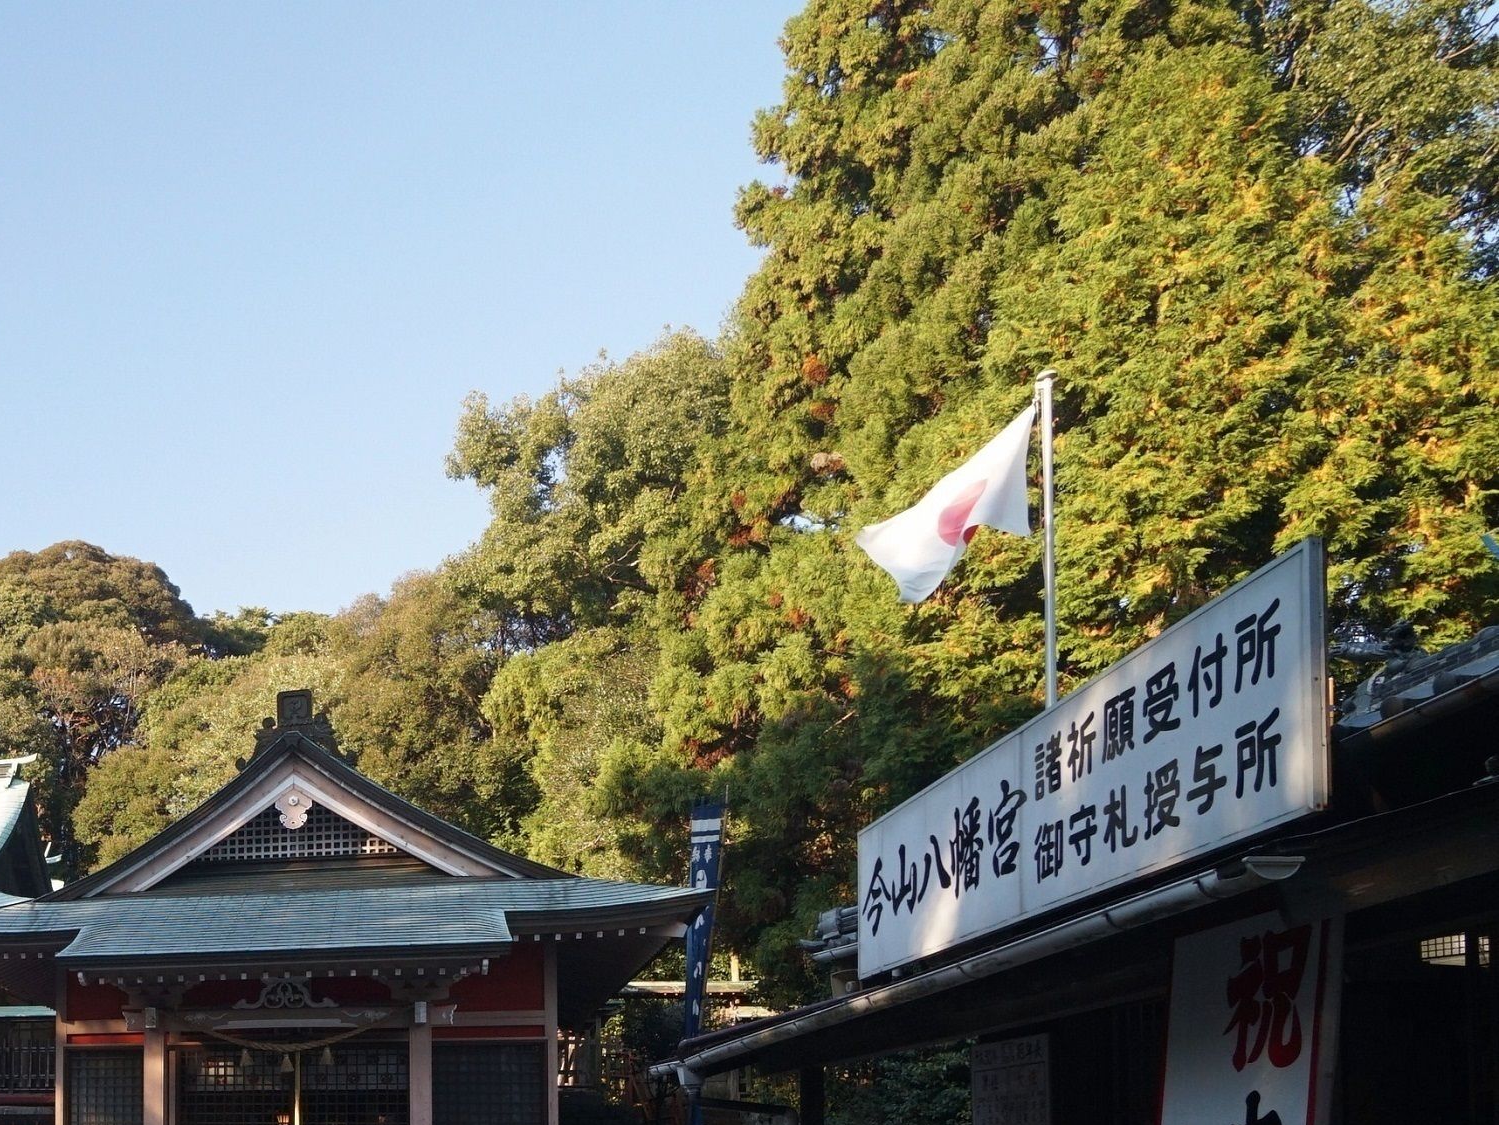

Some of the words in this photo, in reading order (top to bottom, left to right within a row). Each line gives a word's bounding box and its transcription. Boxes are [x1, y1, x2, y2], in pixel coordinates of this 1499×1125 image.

[1034, 597, 1282, 802] 諸祈願受付所
[862, 779, 1027, 936] 今山八幡宮
[1034, 706, 1282, 885] 御守札授与所
[1223, 924, 1313, 1073] 祝
